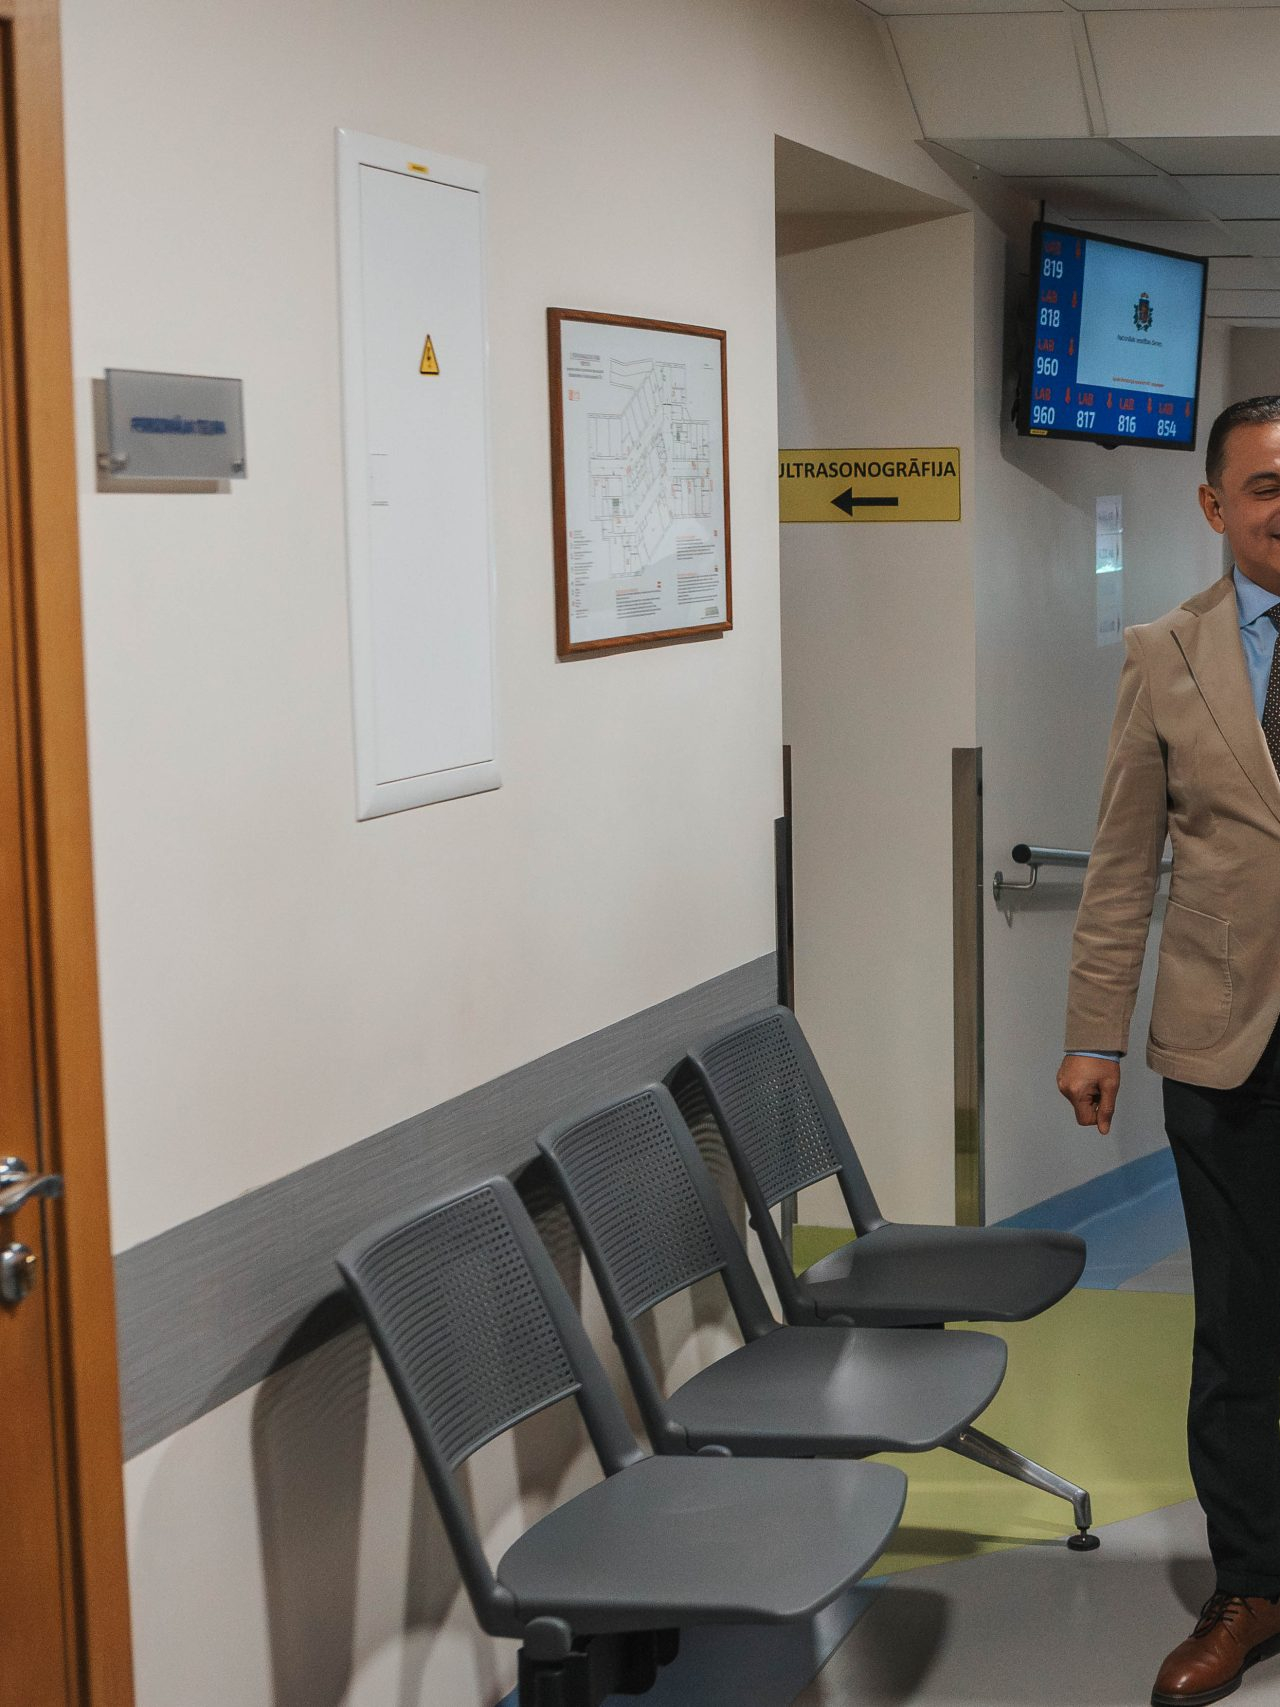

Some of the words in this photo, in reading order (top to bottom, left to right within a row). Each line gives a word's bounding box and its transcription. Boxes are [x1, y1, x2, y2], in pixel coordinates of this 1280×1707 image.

[1043, 258, 1063, 278] 819
[1040, 307, 1060, 328] 818
[1036, 356, 1059, 377] 960
[1035, 388, 1051, 401] LAB
[1033, 405, 1055, 425] 960
[1076, 410, 1096, 429] 817
[1118, 414, 1137, 434] 816
[1157, 419, 1177, 437] 854
